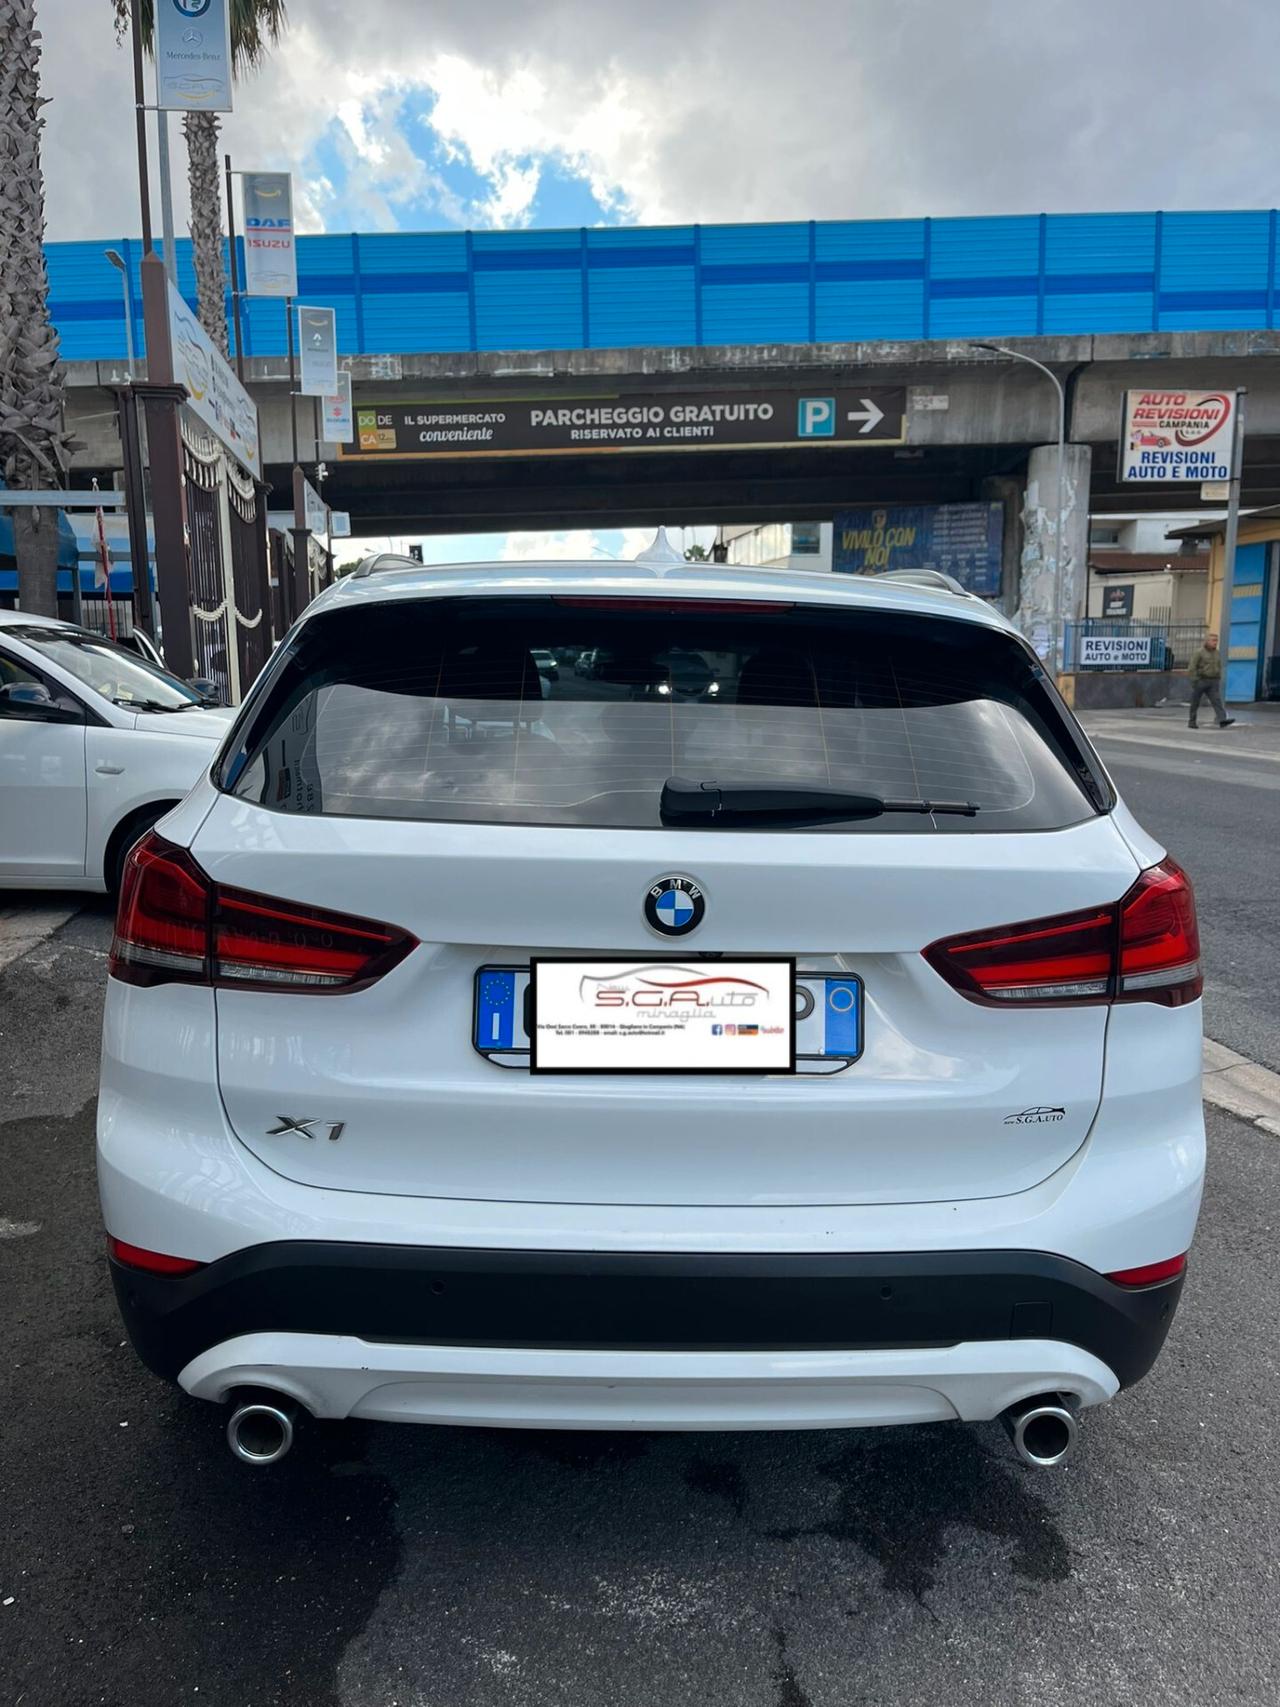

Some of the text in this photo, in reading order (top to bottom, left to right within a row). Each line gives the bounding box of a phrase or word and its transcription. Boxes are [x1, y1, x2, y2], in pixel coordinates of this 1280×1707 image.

[247, 218, 290, 227] DAF
[248, 239, 290, 248] ISUZU
[1139, 394, 1186, 405] AUTO
[377, 415, 393, 425] DE
[405, 413, 506, 425] IL SUPERMERCATO
[531, 403, 773, 426] PARCHEGGIO GRATUITO
[806, 401, 829, 433] P
[1133, 408, 1219, 419] REVISIONI
[1159, 421, 1209, 429] CAMPANIA
[419, 426, 494, 442] conveniente
[571, 426, 714, 440] RISERVATO AI CLIENTI
[1141, 451, 1216, 464] REVISIONI
[1127, 465, 1228, 479] AUTO E MOTO
[886, 527, 916, 547] CON
[864, 547, 891, 566] NOI
[1085, 640, 1148, 651] REVISIONI
[1084, 652, 1111, 661] AUTO
[1121, 652, 1147, 661] MOTO
[650, 879, 701, 899] BMW
[492, 1012, 500, 1040] I
[265, 1115, 345, 1140] X1
